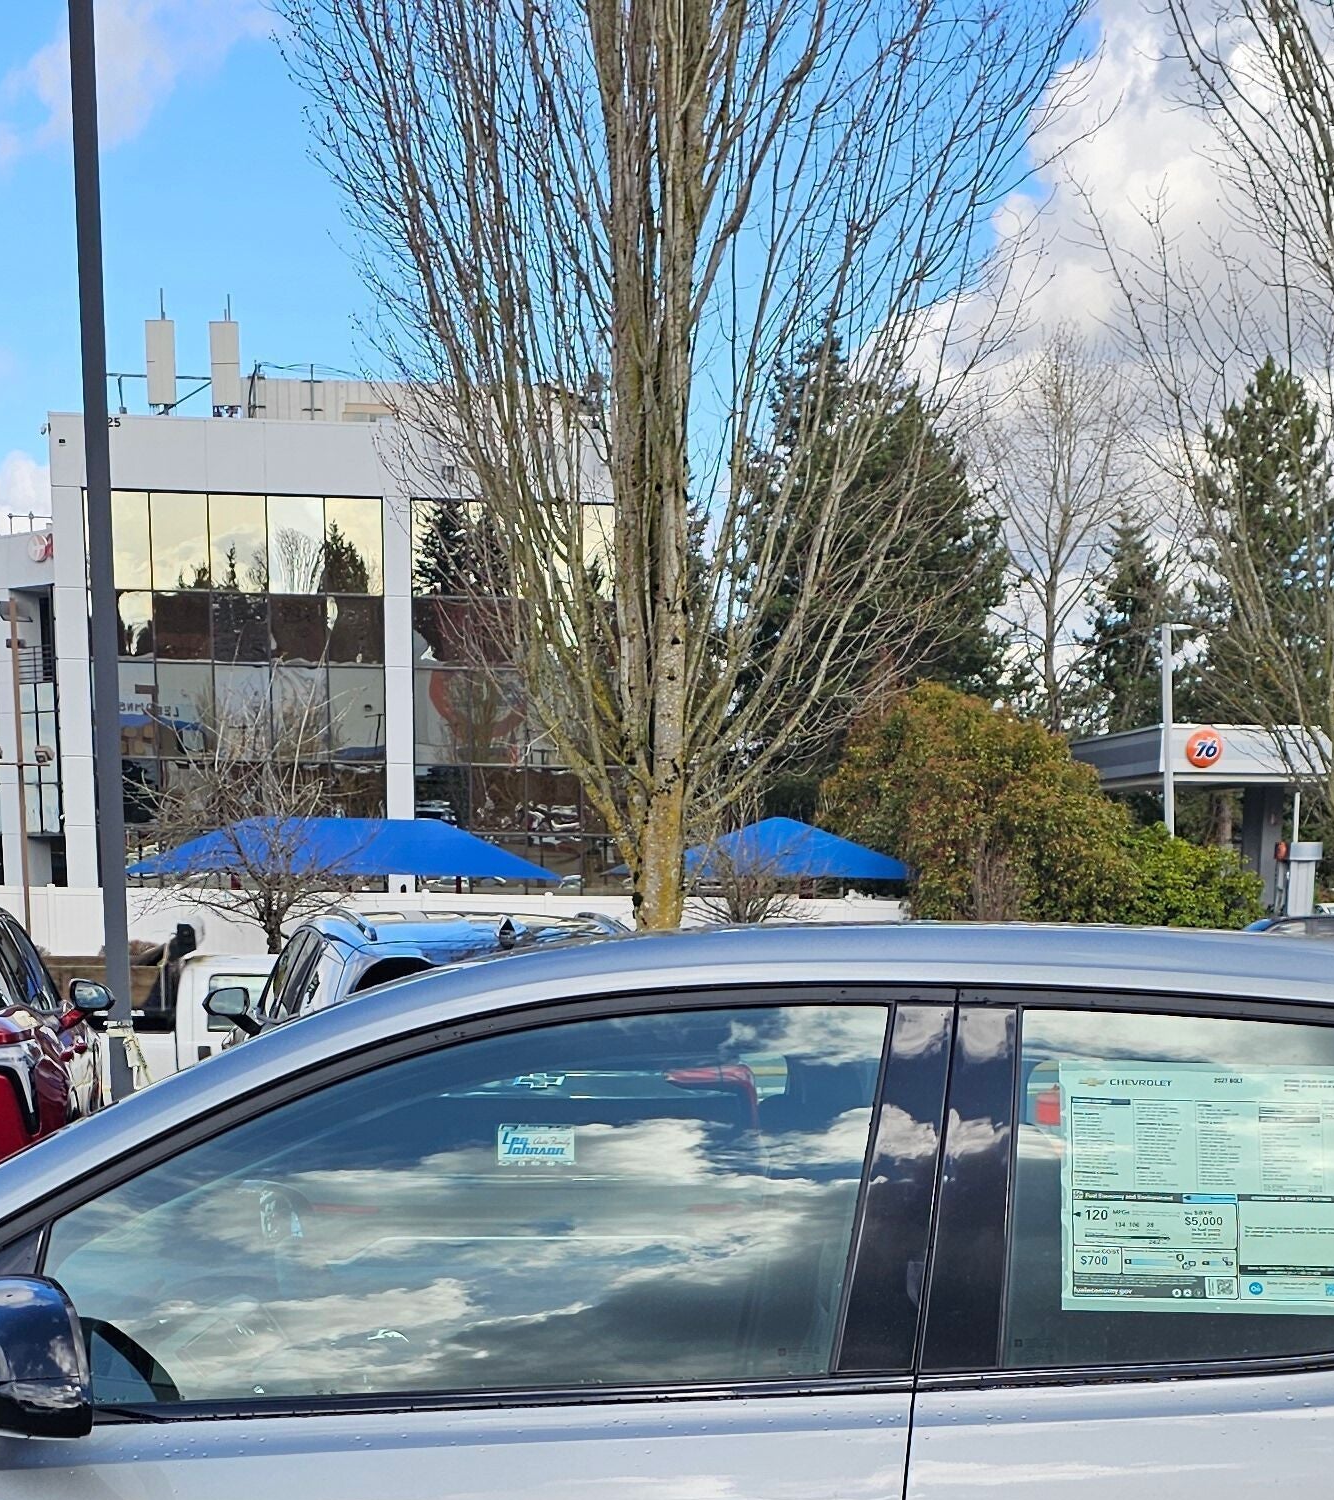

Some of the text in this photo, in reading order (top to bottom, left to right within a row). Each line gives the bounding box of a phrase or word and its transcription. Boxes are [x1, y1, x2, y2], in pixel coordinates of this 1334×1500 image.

[1196, 740, 1218, 758] 76
[1109, 1078, 1173, 1087] CHEVROLET
[502, 1132, 530, 1145] Lee
[503, 1138, 565, 1155] Johnson
[1085, 1209, 1108, 1221] 120
[1184, 1216, 1223, 1227] $5,000
[1080, 1255, 1108, 1266] $700
